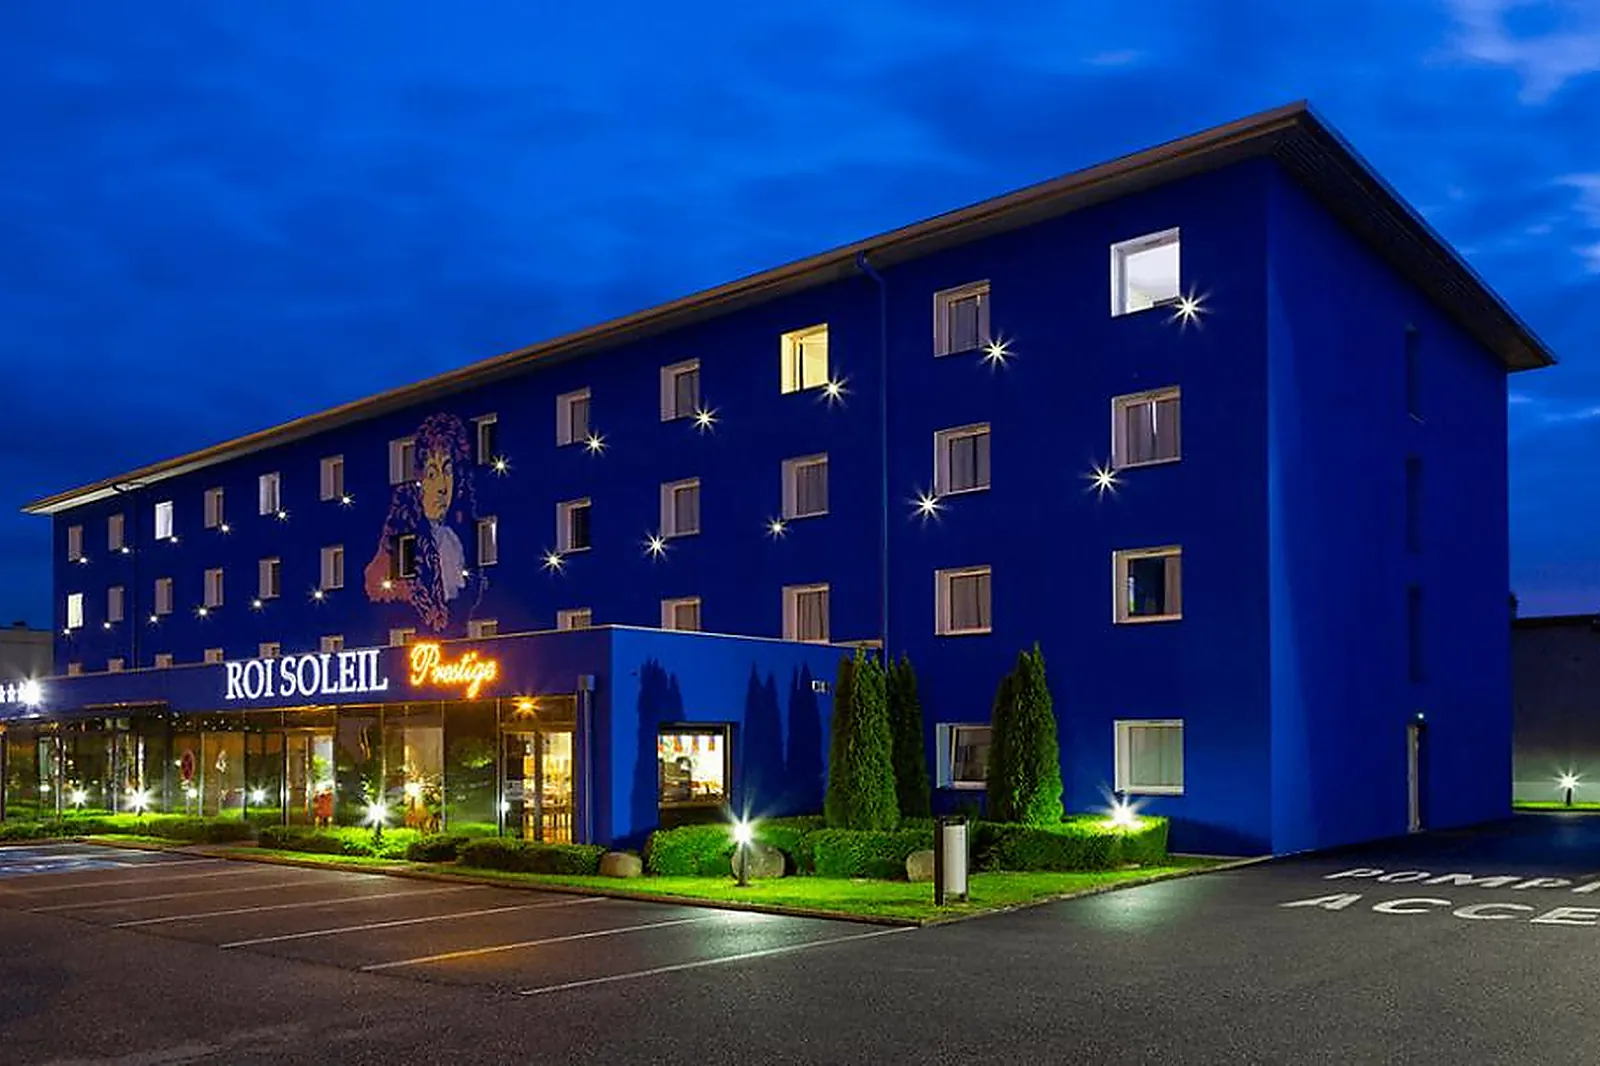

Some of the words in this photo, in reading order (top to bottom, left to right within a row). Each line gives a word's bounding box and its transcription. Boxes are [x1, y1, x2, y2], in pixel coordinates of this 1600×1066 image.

[225, 659, 275, 699] ROI
[280, 649, 388, 696] SOLEIL
[410, 640, 497, 699] Prestige
[1278, 893, 1600, 925] ACCE
